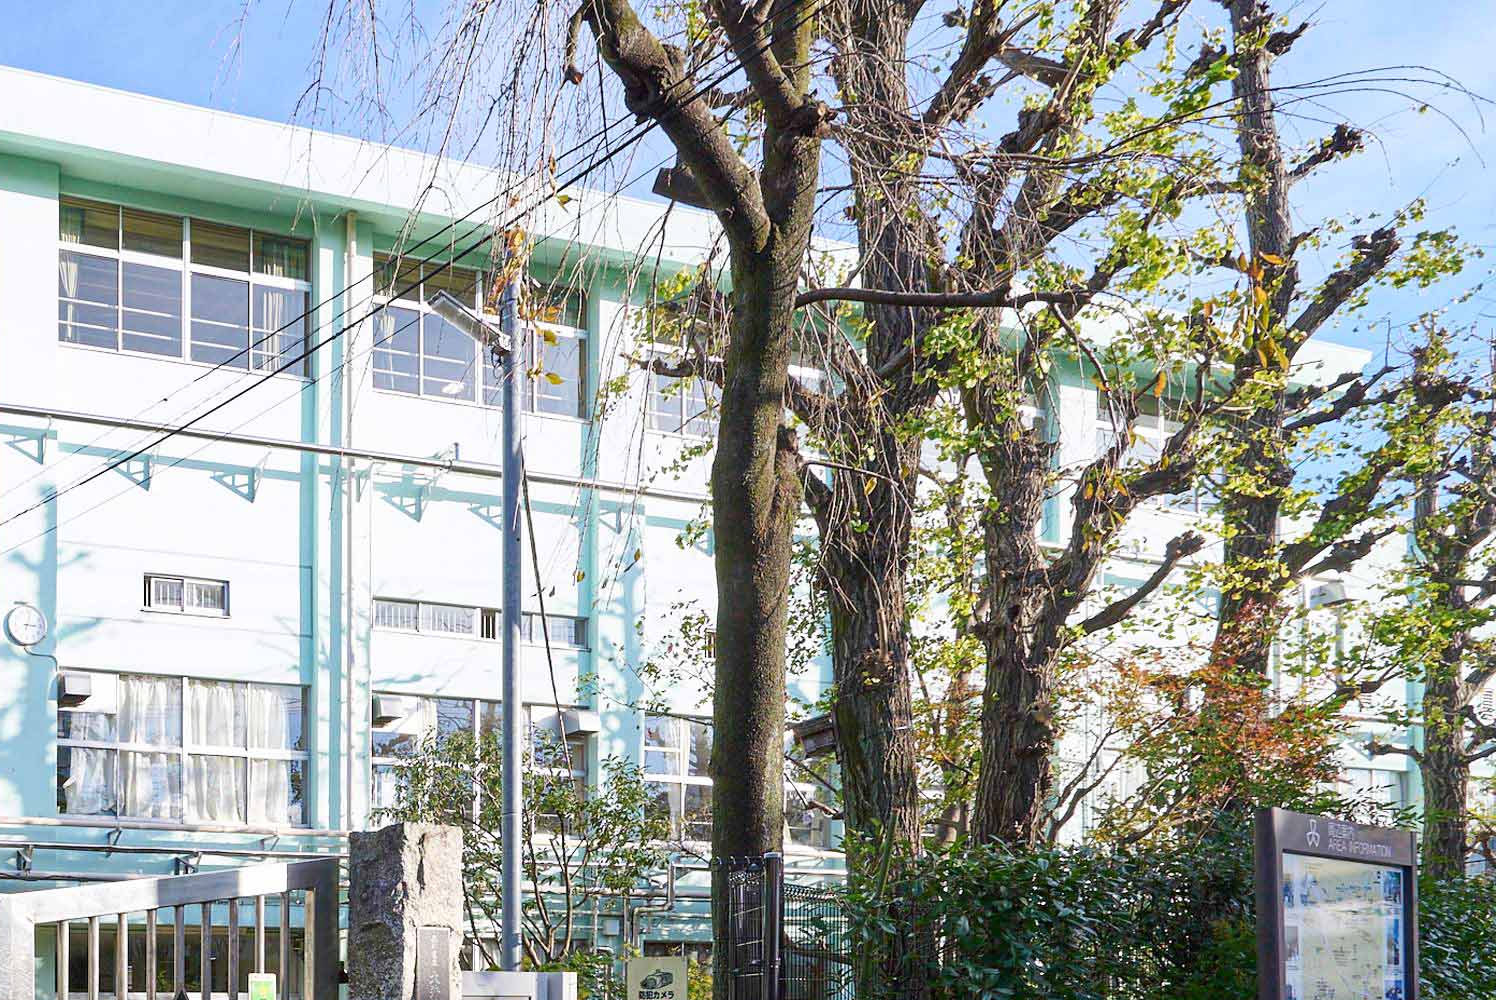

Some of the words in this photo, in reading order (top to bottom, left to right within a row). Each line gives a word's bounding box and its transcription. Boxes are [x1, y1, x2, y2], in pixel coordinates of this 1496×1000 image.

[1328, 838, 1346, 853] AREA
[638, 990, 675, 1000] 防犯カメラ
